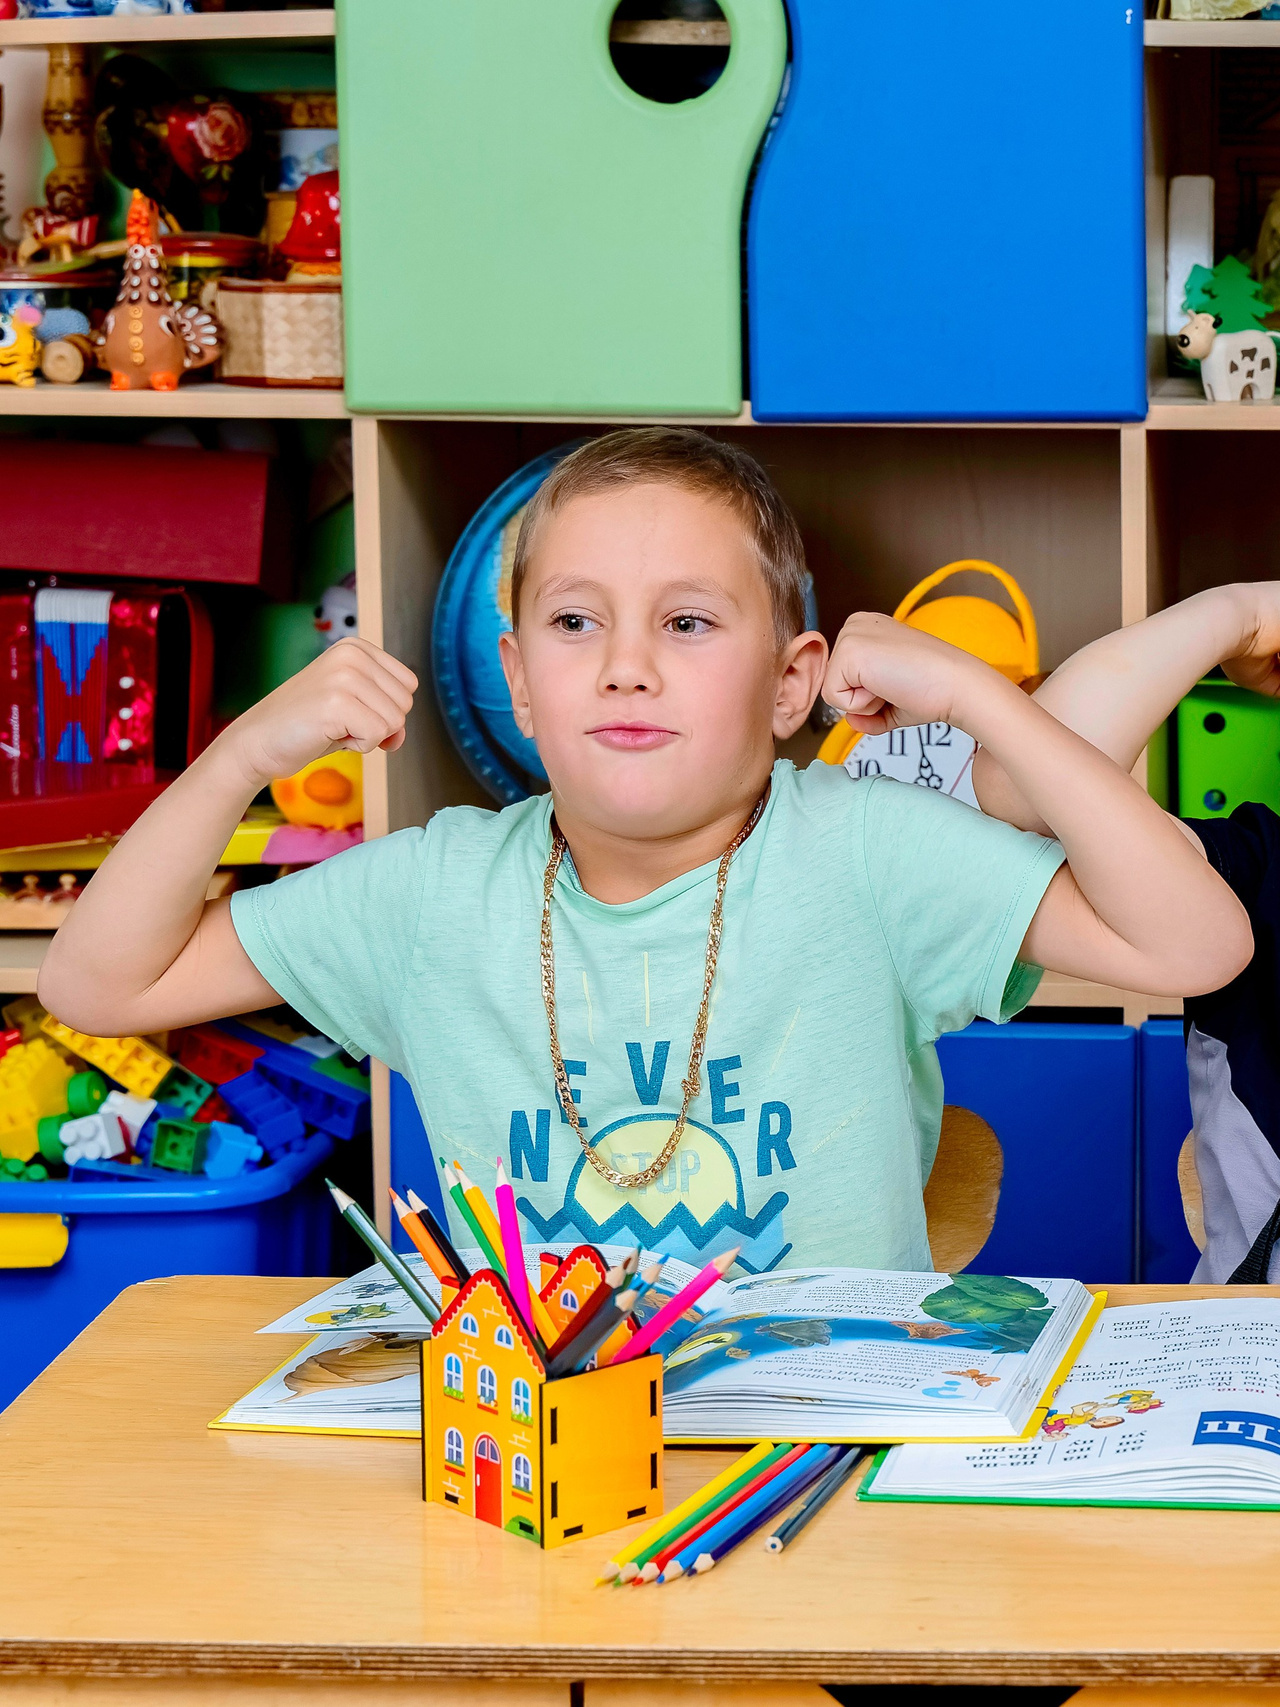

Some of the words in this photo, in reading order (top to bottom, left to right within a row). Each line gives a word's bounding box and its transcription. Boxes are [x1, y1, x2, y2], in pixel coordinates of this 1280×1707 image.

[922, 722, 951, 746] 12
[886, 729, 907, 756] 11
[508, 1040, 798, 1183] NEVER
[854, 1310, 918, 1319] Почему
[752, 1371, 844, 1382] мотыльки
[864, 1373, 926, 1383] летят
[1064, 1375, 1116, 1384] шап-к
[1067, 1370, 1118, 1378] пуш-к
[848, 1377, 917, 1390] Почему
